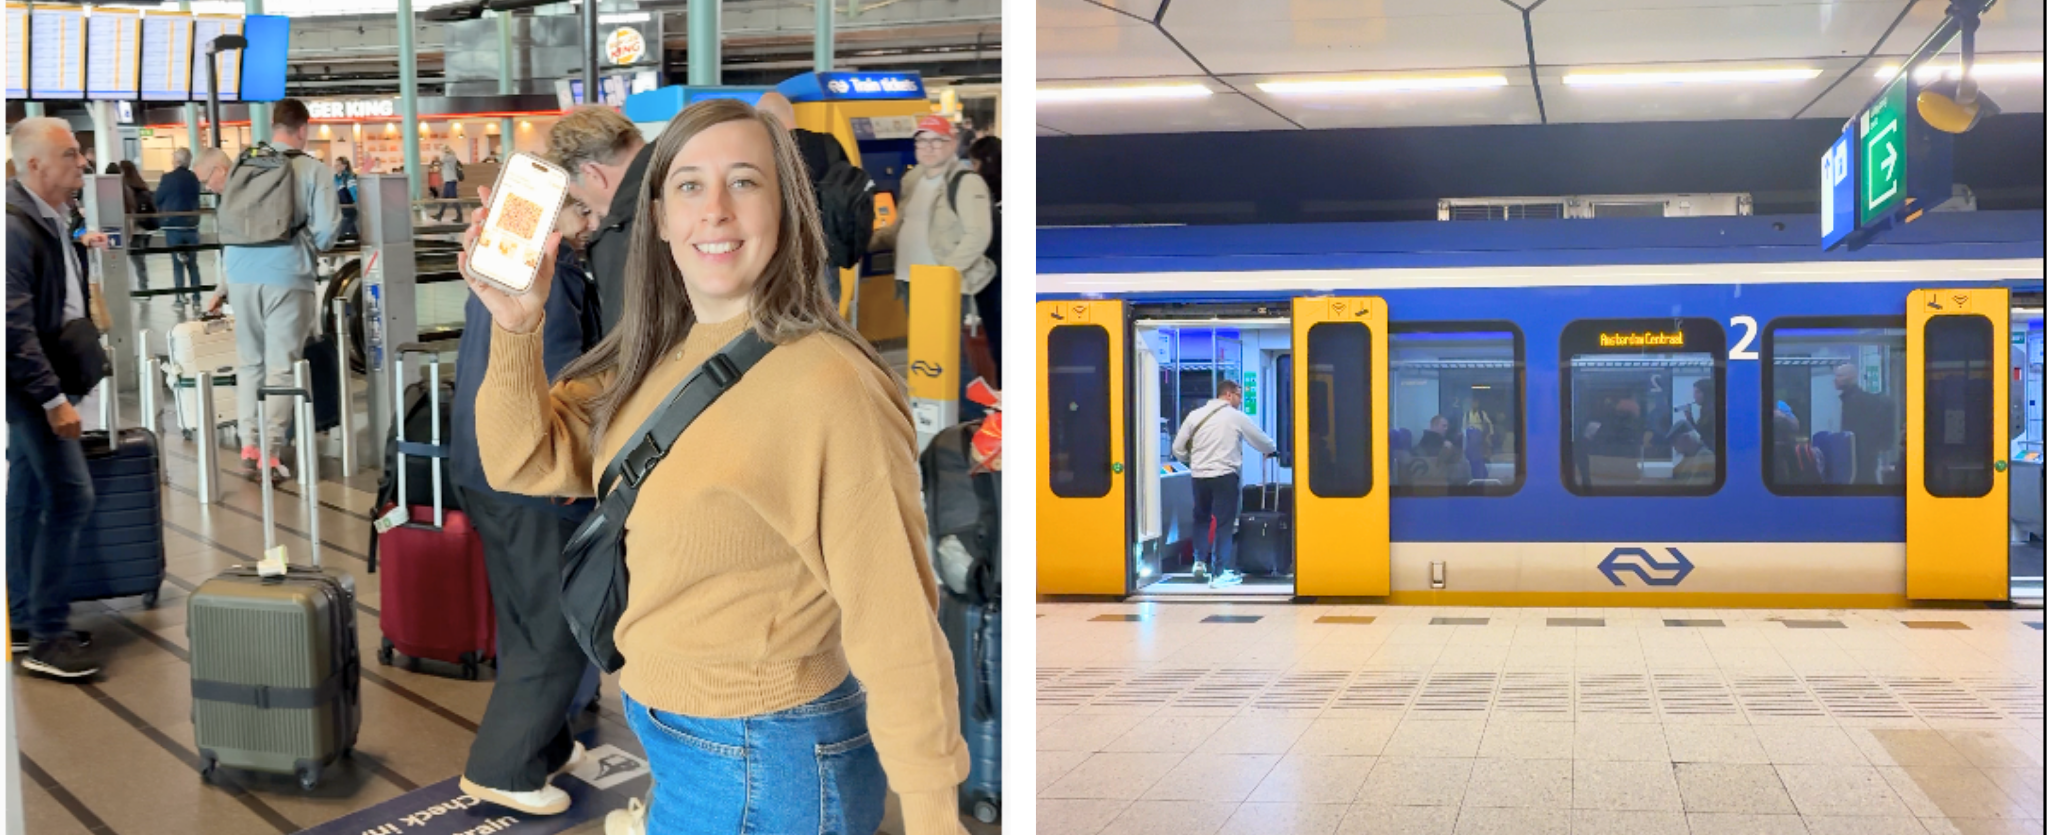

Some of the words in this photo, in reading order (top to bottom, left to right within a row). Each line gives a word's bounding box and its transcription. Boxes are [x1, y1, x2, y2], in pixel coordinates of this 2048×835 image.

[849, 77, 881, 92] Train
[881, 77, 918, 92] tickets
[308, 101, 344, 118] GER
[345, 100, 393, 117] KING
[1645, 330, 1684, 346] Centraal
[1728, 315, 1759, 360] 2
[398, 795, 481, 827] Check
